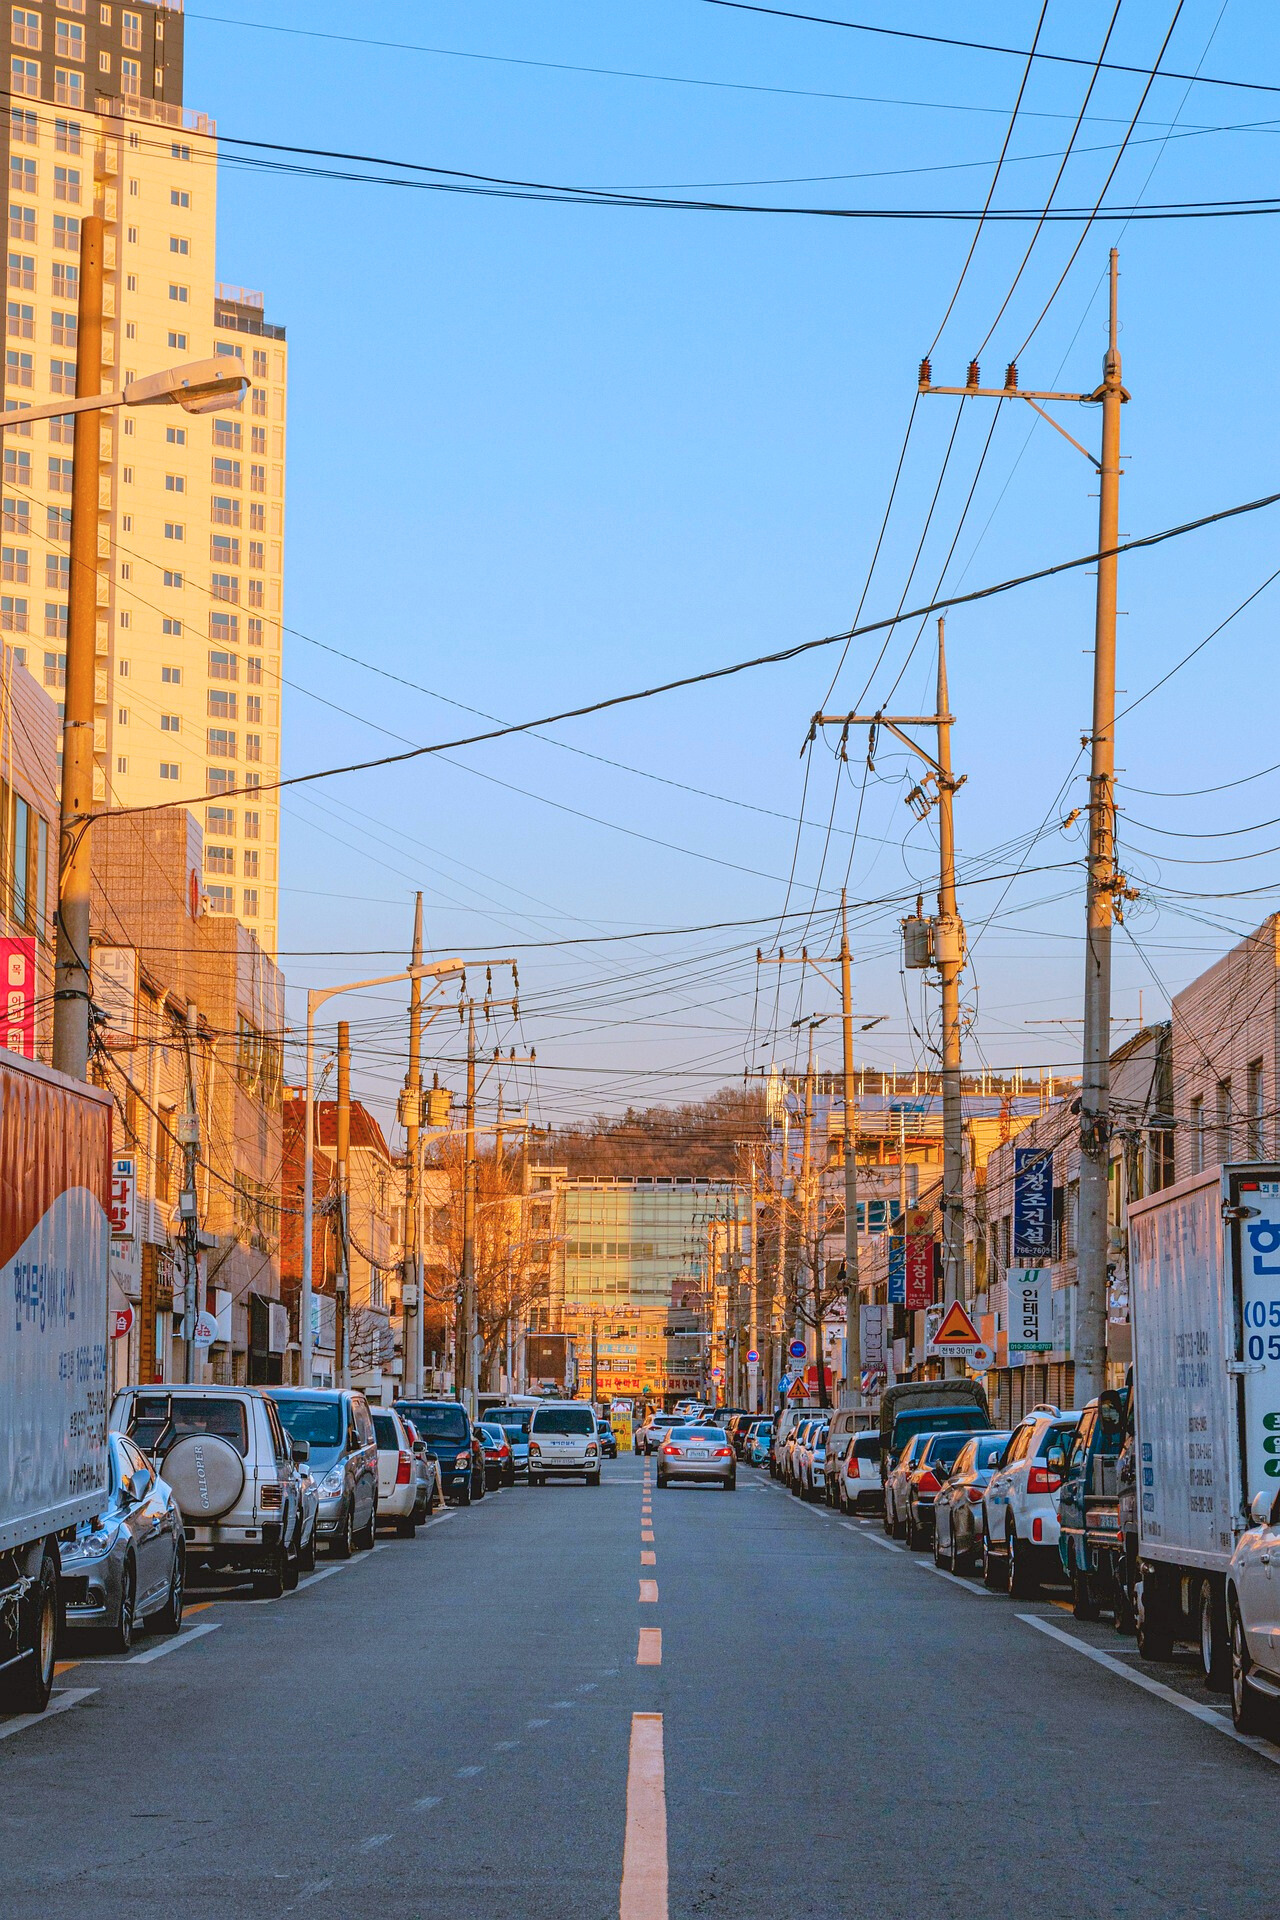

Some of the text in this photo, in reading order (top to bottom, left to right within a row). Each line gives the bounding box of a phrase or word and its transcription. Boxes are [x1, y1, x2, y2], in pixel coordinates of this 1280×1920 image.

[1018, 1269, 1040, 1283] JJ
[1022, 1289, 1039, 1341] 인테리어
[941, 1347, 955, 1355] 전방
[194, 1446, 210, 1509] GALLOPER
